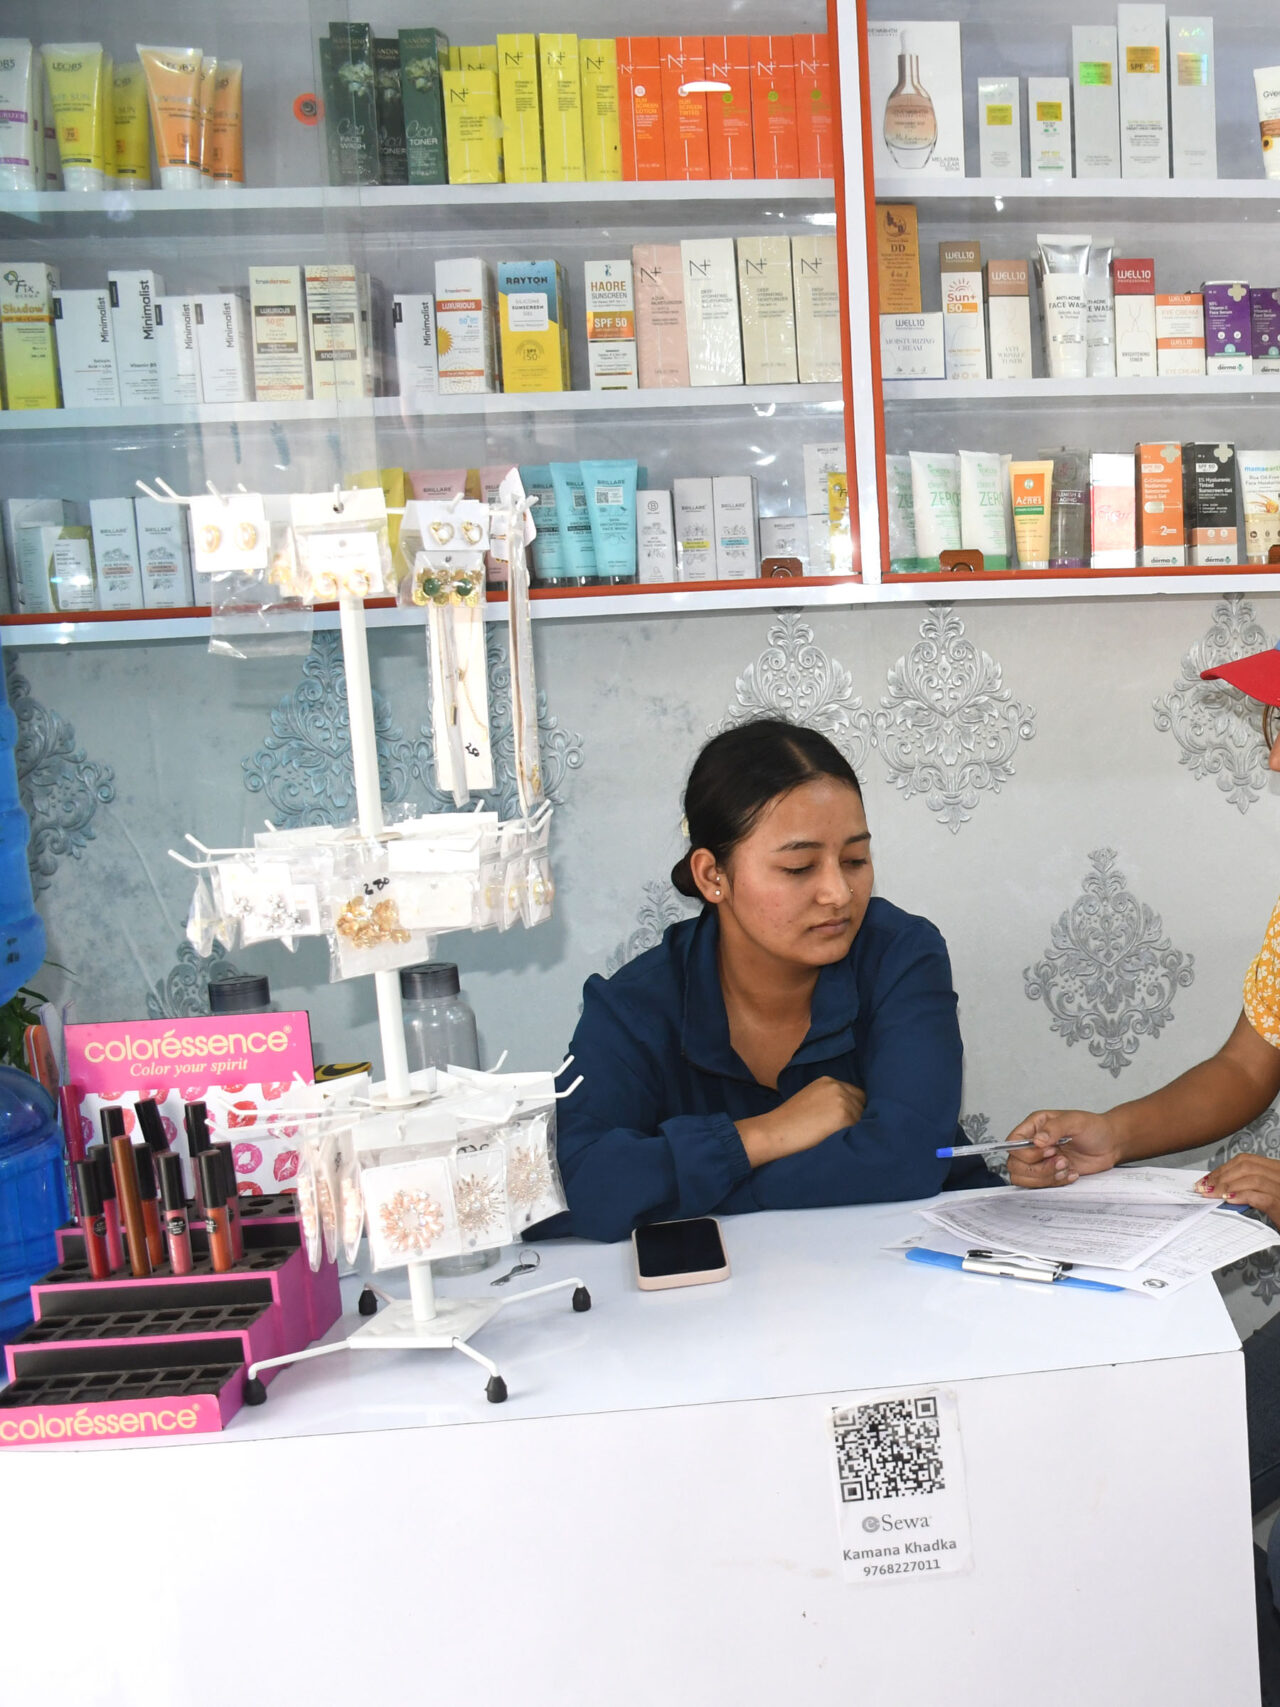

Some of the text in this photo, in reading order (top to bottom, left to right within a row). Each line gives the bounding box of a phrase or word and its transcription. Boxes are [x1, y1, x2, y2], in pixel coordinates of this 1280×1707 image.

[409, 138, 438, 146] TONER
[890, 243, 906, 253] DD
[945, 251, 975, 259] WELL10
[991, 271, 1026, 281] WELL10
[1117, 270, 1151, 280] WELL10
[592, 292, 628, 300] SUNSCREEN
[947, 293, 976, 303] Sun+
[3, 303, 44, 315] Shadow
[139, 279, 155, 341] Minimalist
[441, 301, 476, 310] LUXURIOUS
[948, 303, 963, 313] 50
[97, 296, 110, 343] Minimalist
[223, 302, 235, 348] Minimalist
[423, 301, 432, 347] Minimalist
[594, 317, 628, 328] SPF 50
[895, 319, 925, 327] WELL10
[182, 303, 194, 350] Minimalist
[1016, 496, 1042, 505] Acnes
[1160, 525, 1168, 536] 2
[85, 1028, 290, 1064] coloréssence
[130, 1058, 248, 1079] Color your spirit
[0, 1407, 198, 1441] coloréssence
[843, 1538, 957, 1561] Kamana Khadka
[863, 1558, 941, 1577] 9768227011
